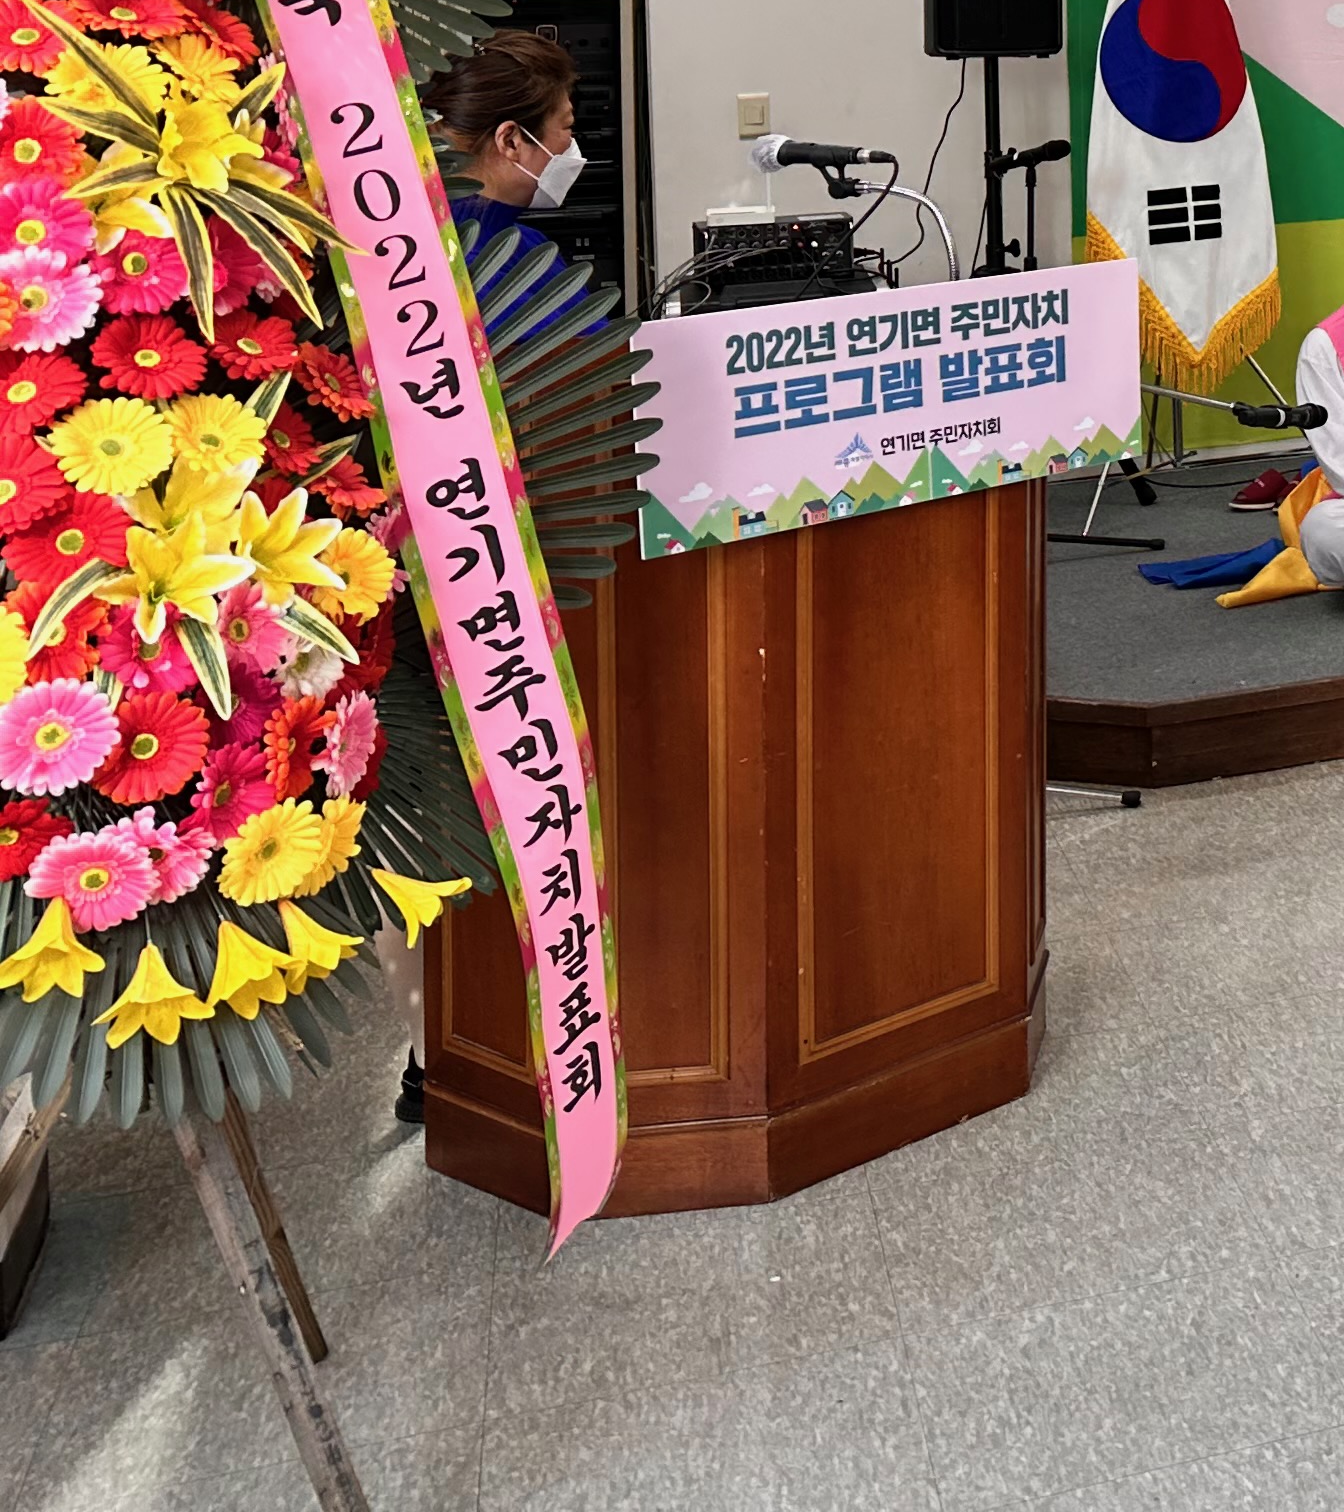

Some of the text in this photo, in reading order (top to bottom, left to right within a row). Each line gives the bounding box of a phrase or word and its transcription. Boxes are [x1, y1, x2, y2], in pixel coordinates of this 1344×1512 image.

[725, 289, 1069, 376] 2022년 연기면 주민자치
[734, 335, 1067, 439] 프로그램 발표회
[880, 416, 1001, 456] 연기면 주민자치회
[330, 102, 460, 419] 2022년
[426, 457, 602, 1113] 연기면주민자치발표회
